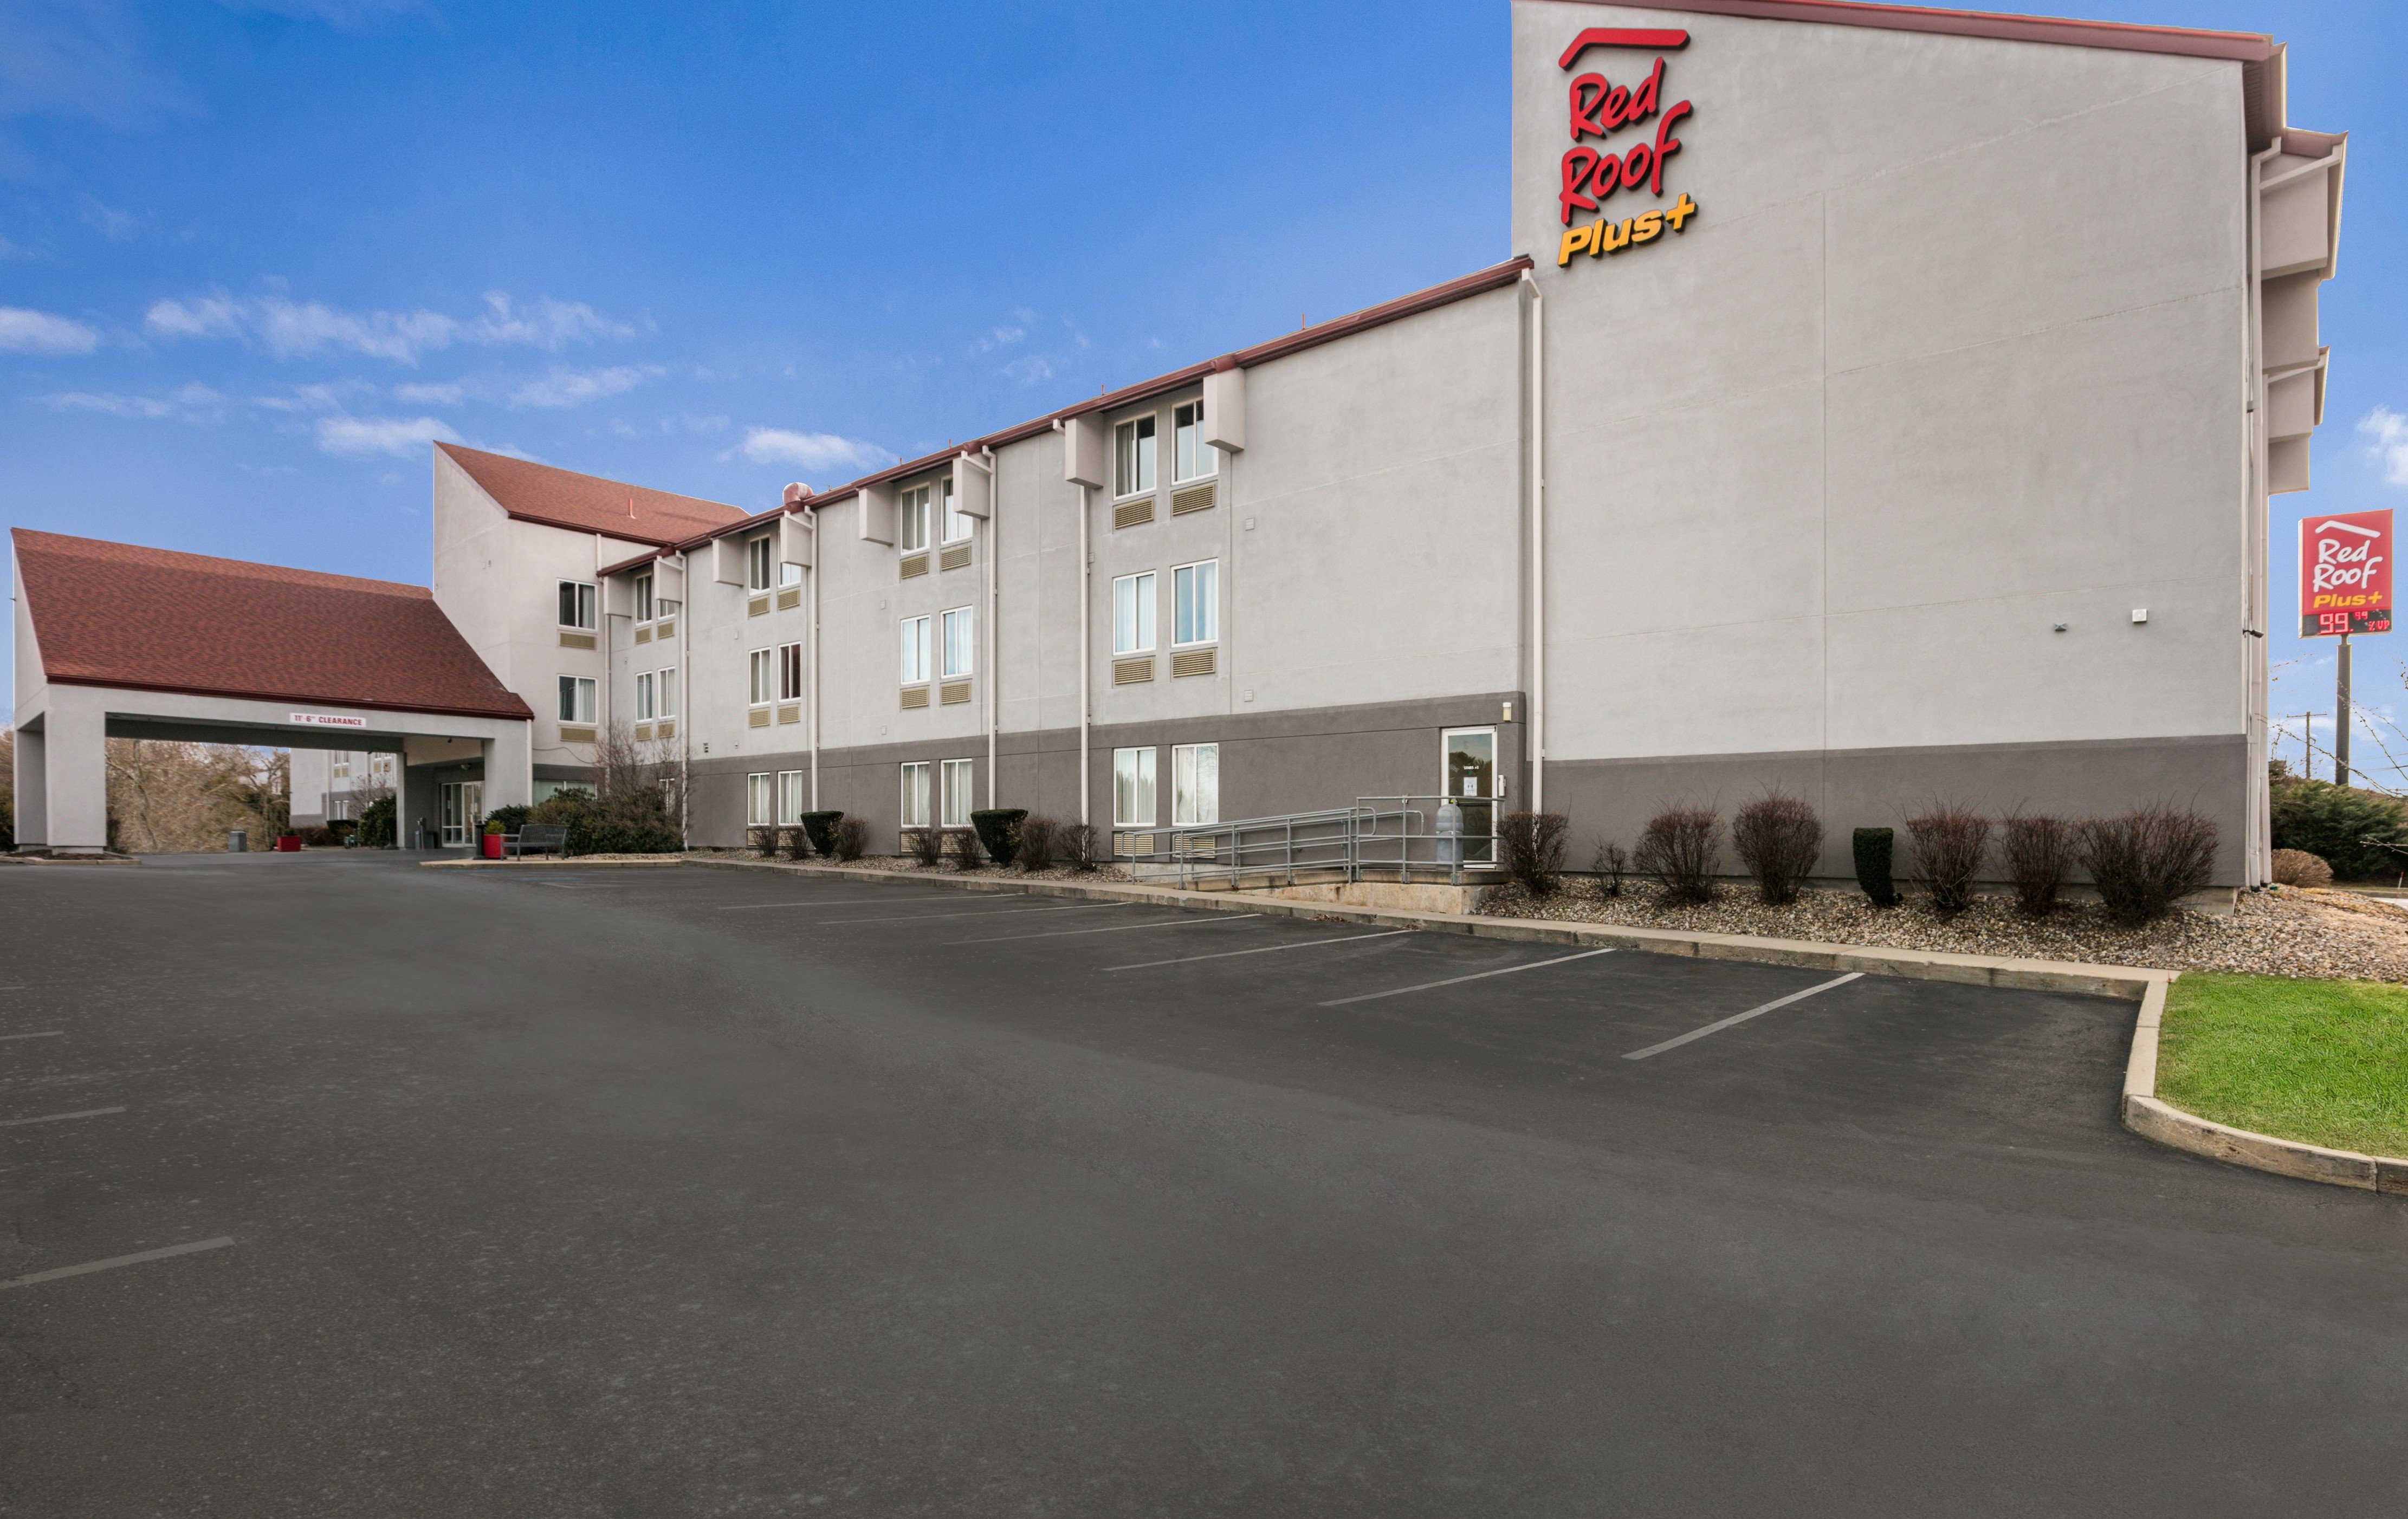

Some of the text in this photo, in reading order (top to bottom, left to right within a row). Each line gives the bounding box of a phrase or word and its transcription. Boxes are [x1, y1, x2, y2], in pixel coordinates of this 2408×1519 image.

[1569, 56, 1665, 141] Red
[1559, 100, 1693, 225] Roof
[1558, 193, 1698, 267] Plus+
[2319, 538, 2371, 564] Red
[2313, 556, 2383, 593] Roof
[2313, 591, 2383, 608] Plus+
[319, 716, 363, 726] CLEARANCE
